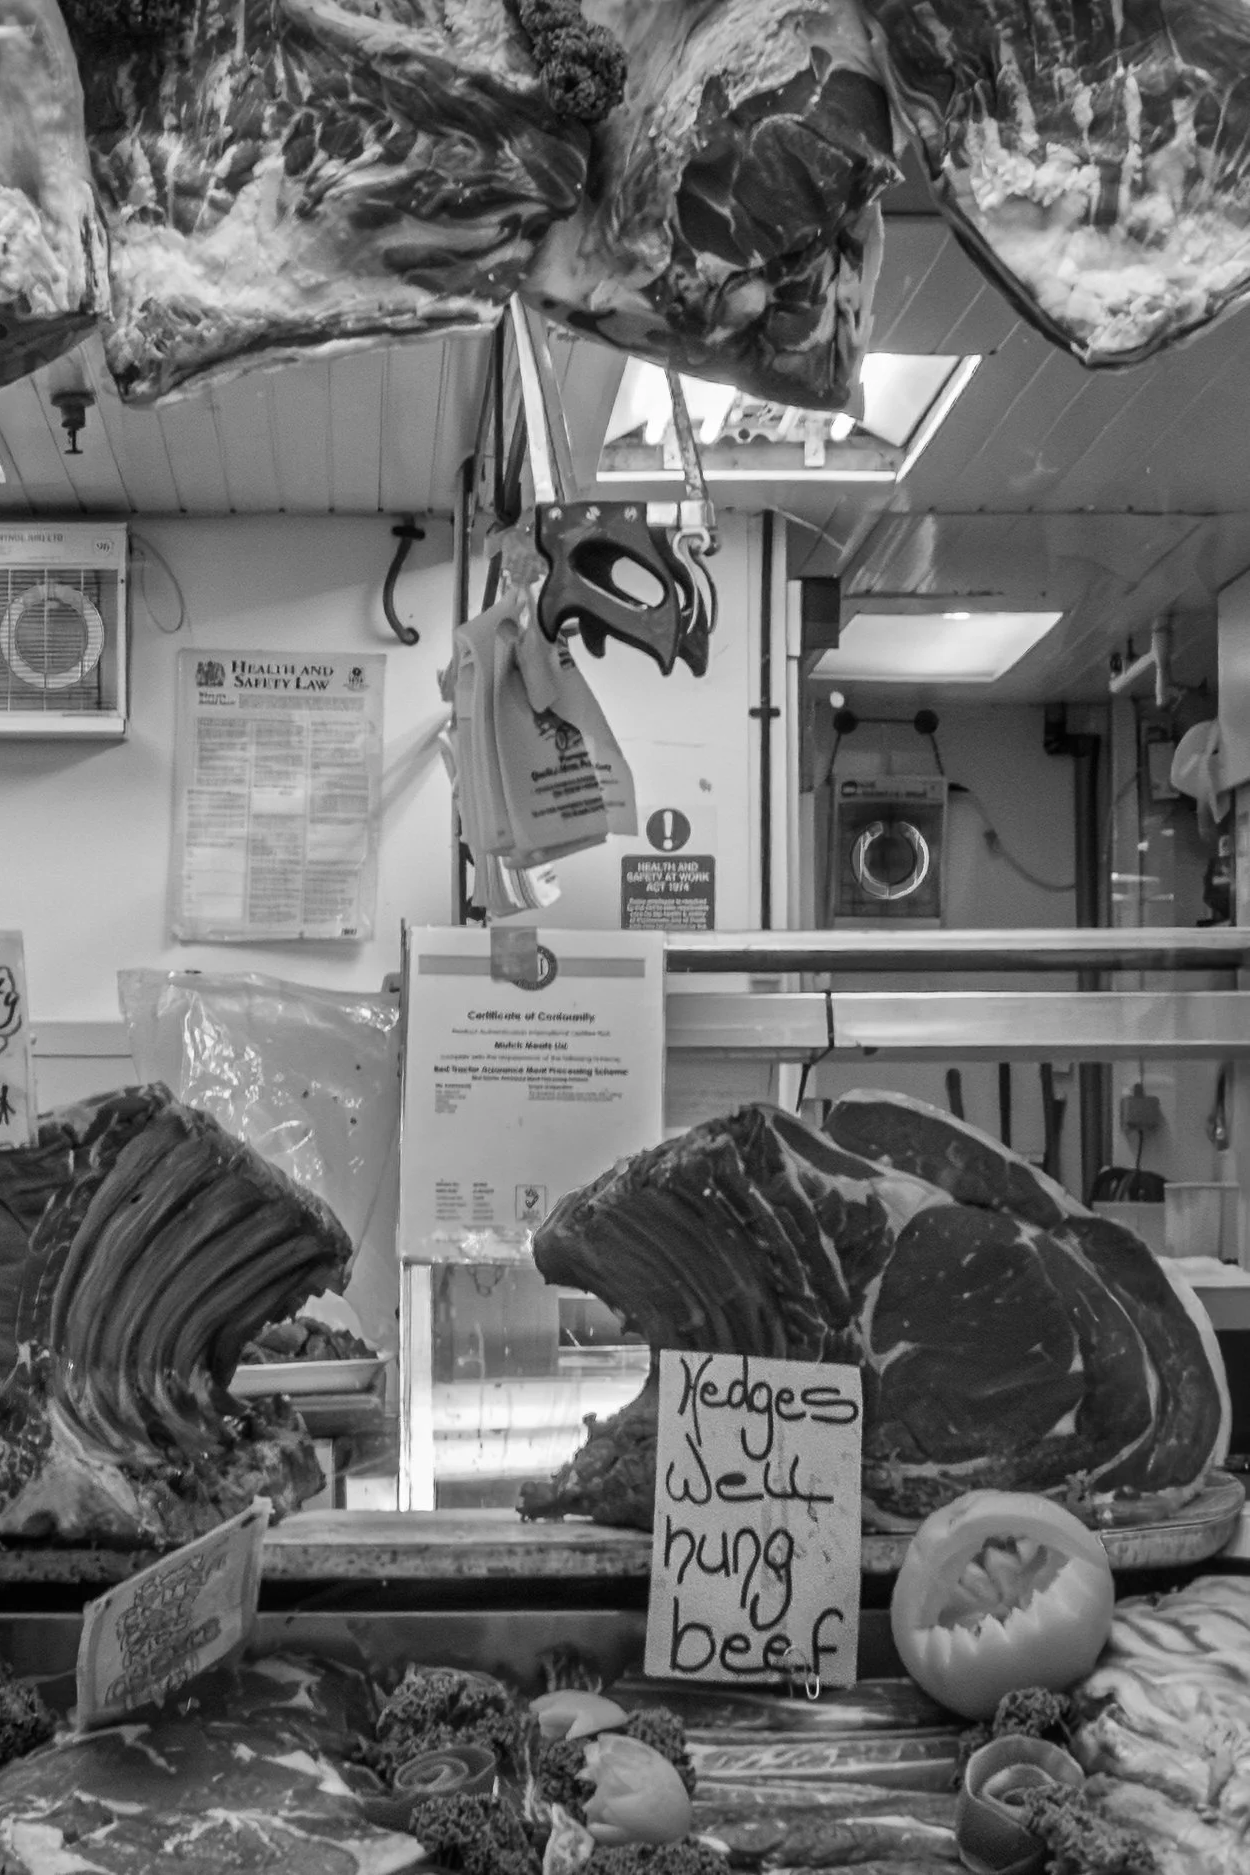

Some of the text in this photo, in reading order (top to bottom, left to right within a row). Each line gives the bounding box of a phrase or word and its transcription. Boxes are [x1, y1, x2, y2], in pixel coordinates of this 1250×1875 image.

[231, 660, 334, 677] HEALTH AND
[233, 675, 330, 692] SAFETY LAW
[637, 861, 699, 872] HEALTH AND
[626, 871, 710, 882] SAFETY AT WORK
[646, 881, 665, 892] ACT
[467, 1010, 595, 1024] Certificate of Conformity
[525, 1041, 552, 1050] Meats
[481, 1065, 524, 1074] Assurance
[526, 1066, 548, 1074] Meat
[549, 1067, 592, 1077] Processing
[594, 1067, 629, 1077] Scheme
[678, 1354, 859, 1461] Hedges
[666, 1432, 834, 1504] Well
[664, 1515, 794, 1632] hung
[670, 1596, 844, 1674] beef
